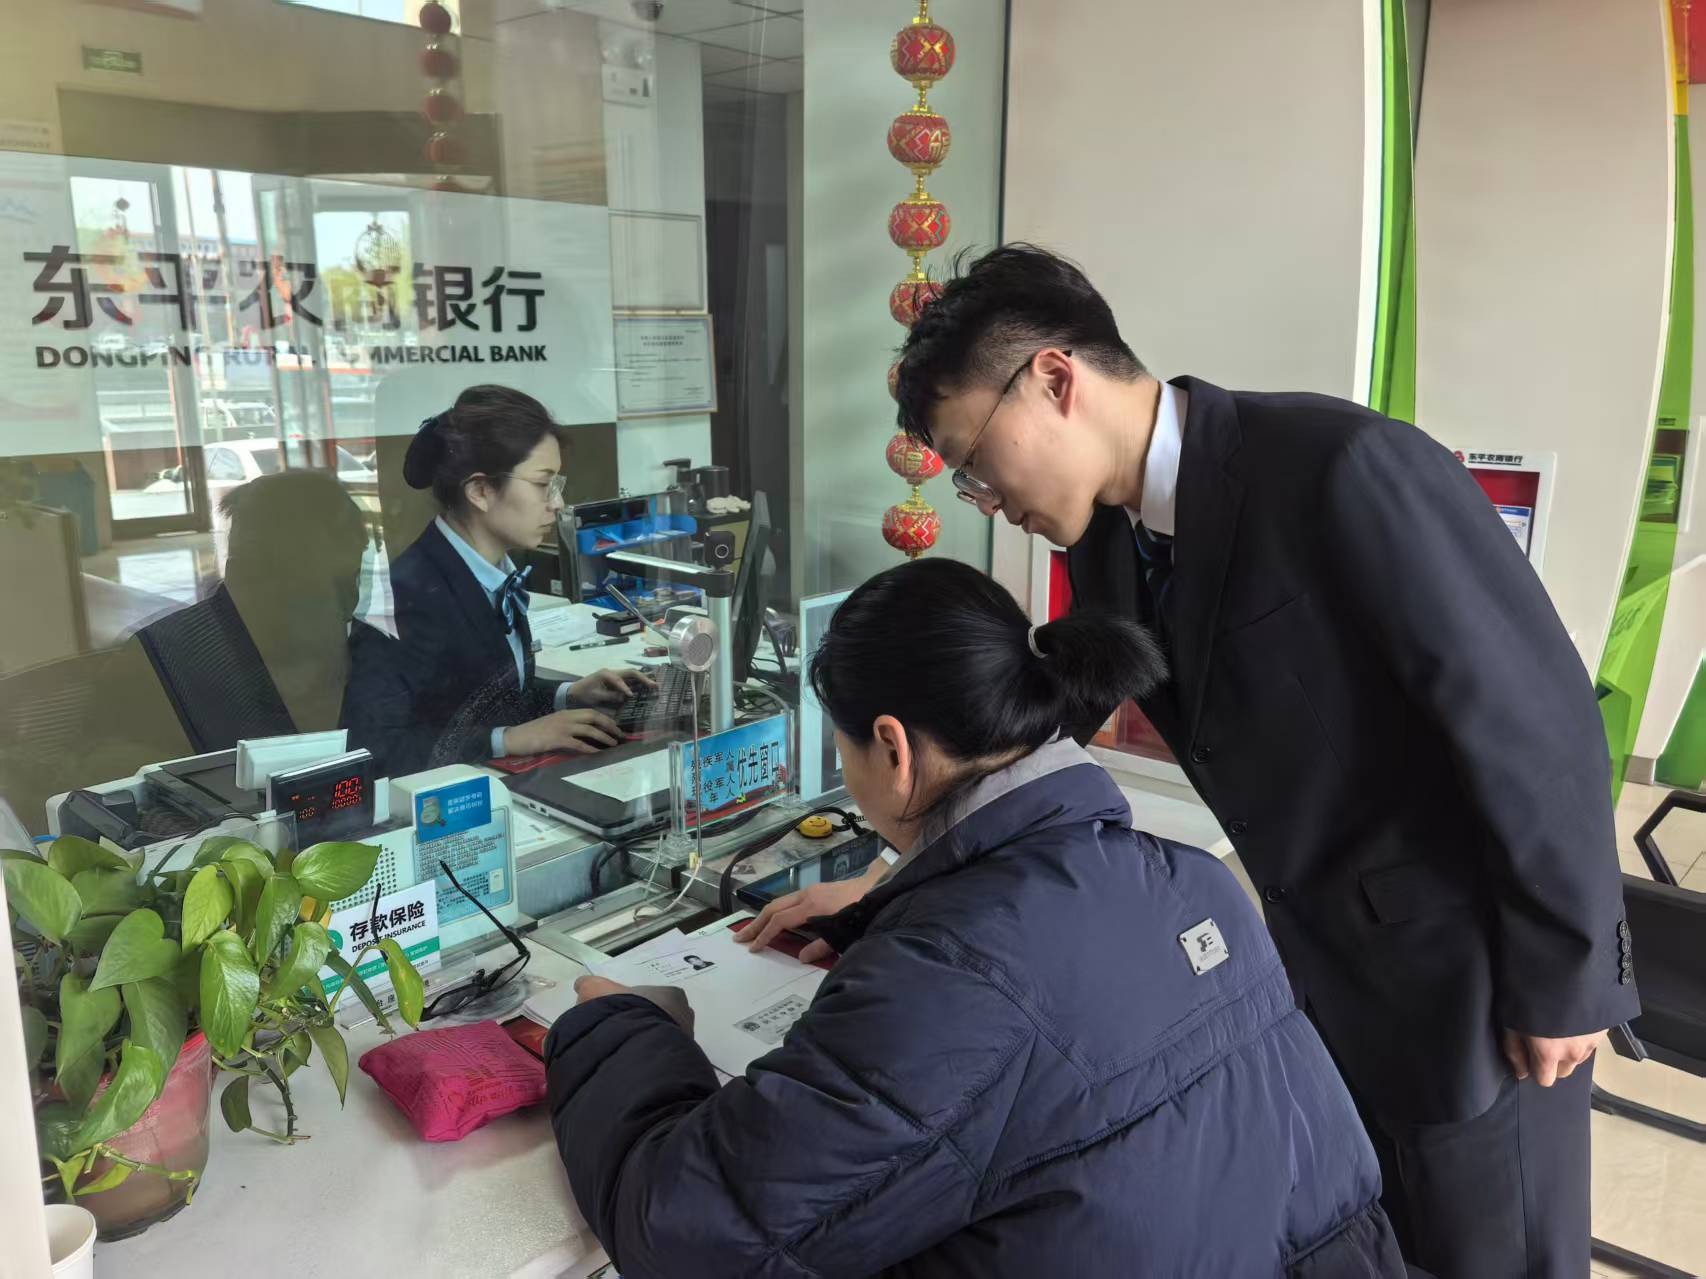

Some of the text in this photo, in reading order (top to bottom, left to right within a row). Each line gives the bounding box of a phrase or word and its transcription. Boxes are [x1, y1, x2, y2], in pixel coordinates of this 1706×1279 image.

[325, 345, 485, 366] MMERCIAL
[490, 345, 547, 363] BANK
[737, 740, 779, 790] 优先窗口
[349, 900, 424, 942] 存款保险
[352, 920, 426, 953] DEPOST INSURANCE
